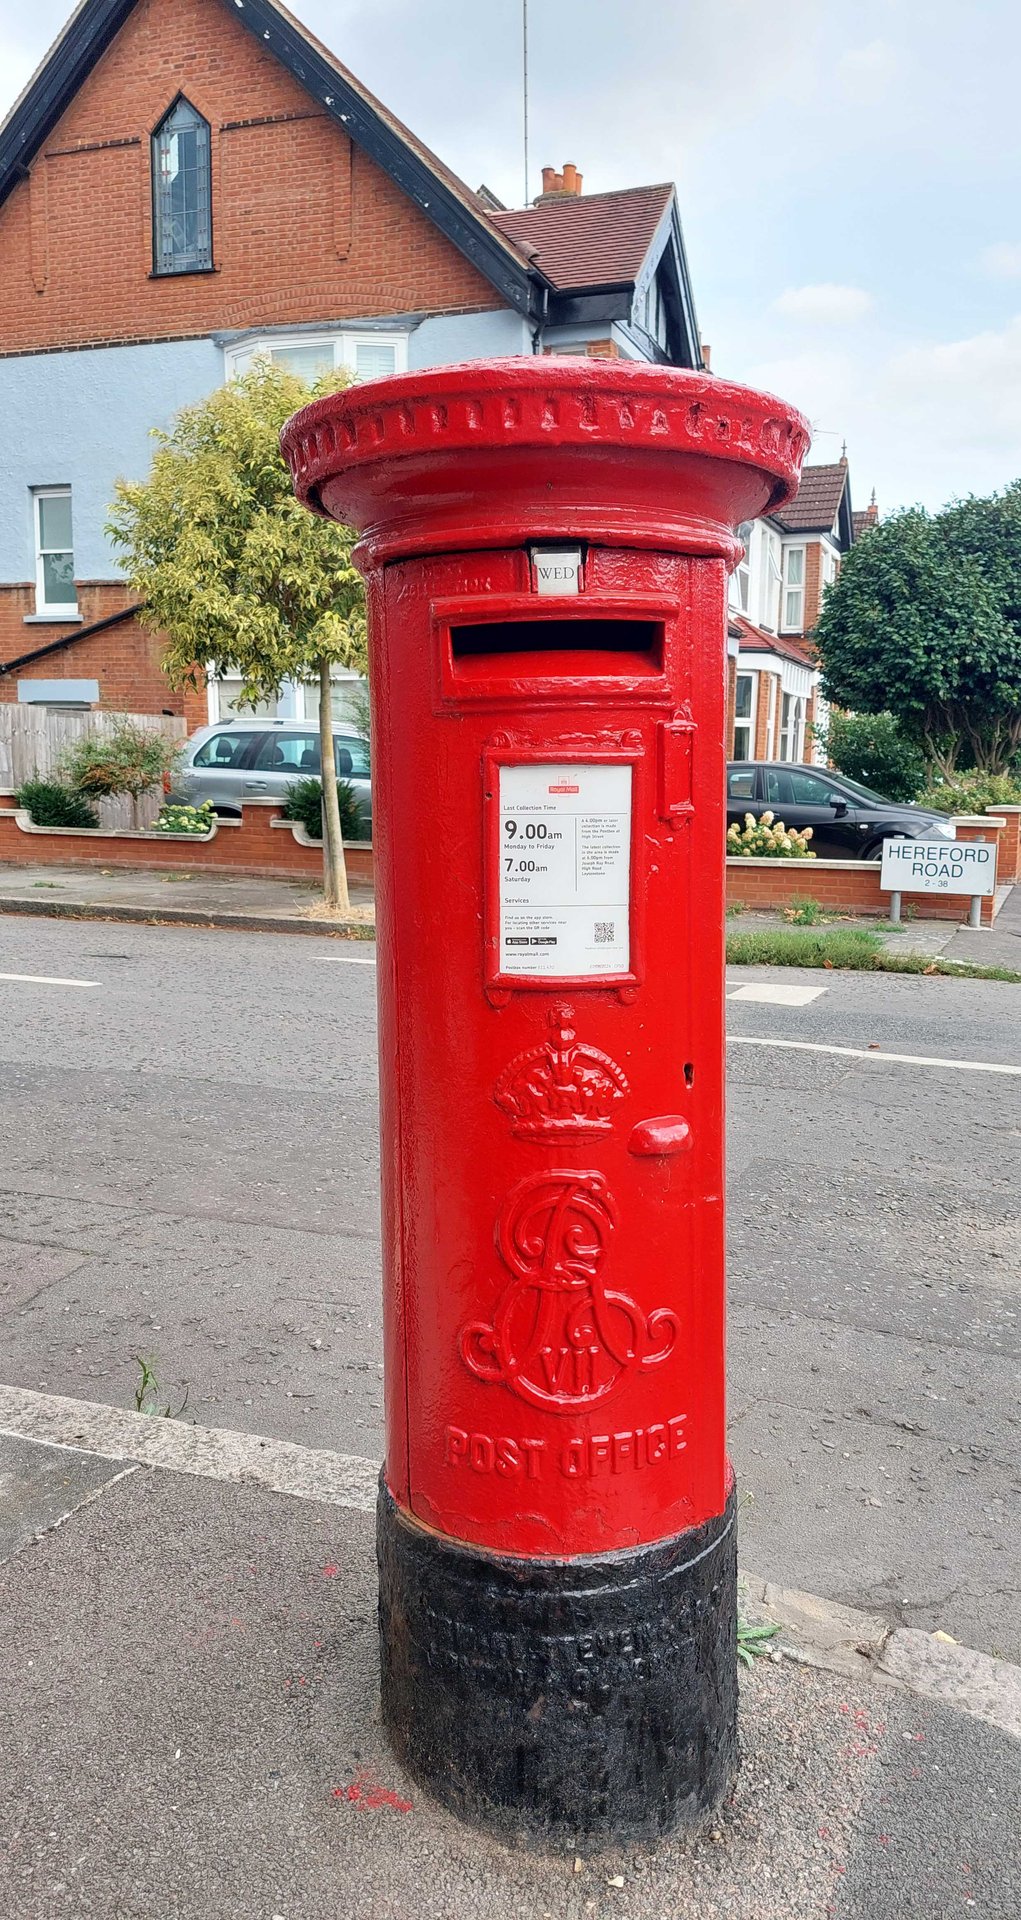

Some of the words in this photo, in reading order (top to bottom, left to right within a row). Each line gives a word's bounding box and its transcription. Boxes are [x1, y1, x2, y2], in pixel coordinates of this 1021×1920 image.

[538, 566, 574, 580] WED
[504, 820, 562, 839] 9.00am
[888, 845, 990, 863] HEREFORD
[504, 858, 548, 872] 7.00am
[912, 862, 963, 878] ROAD
[446, 1425, 546, 1479] POST
[561, 1413, 688, 1479] OFFICE
